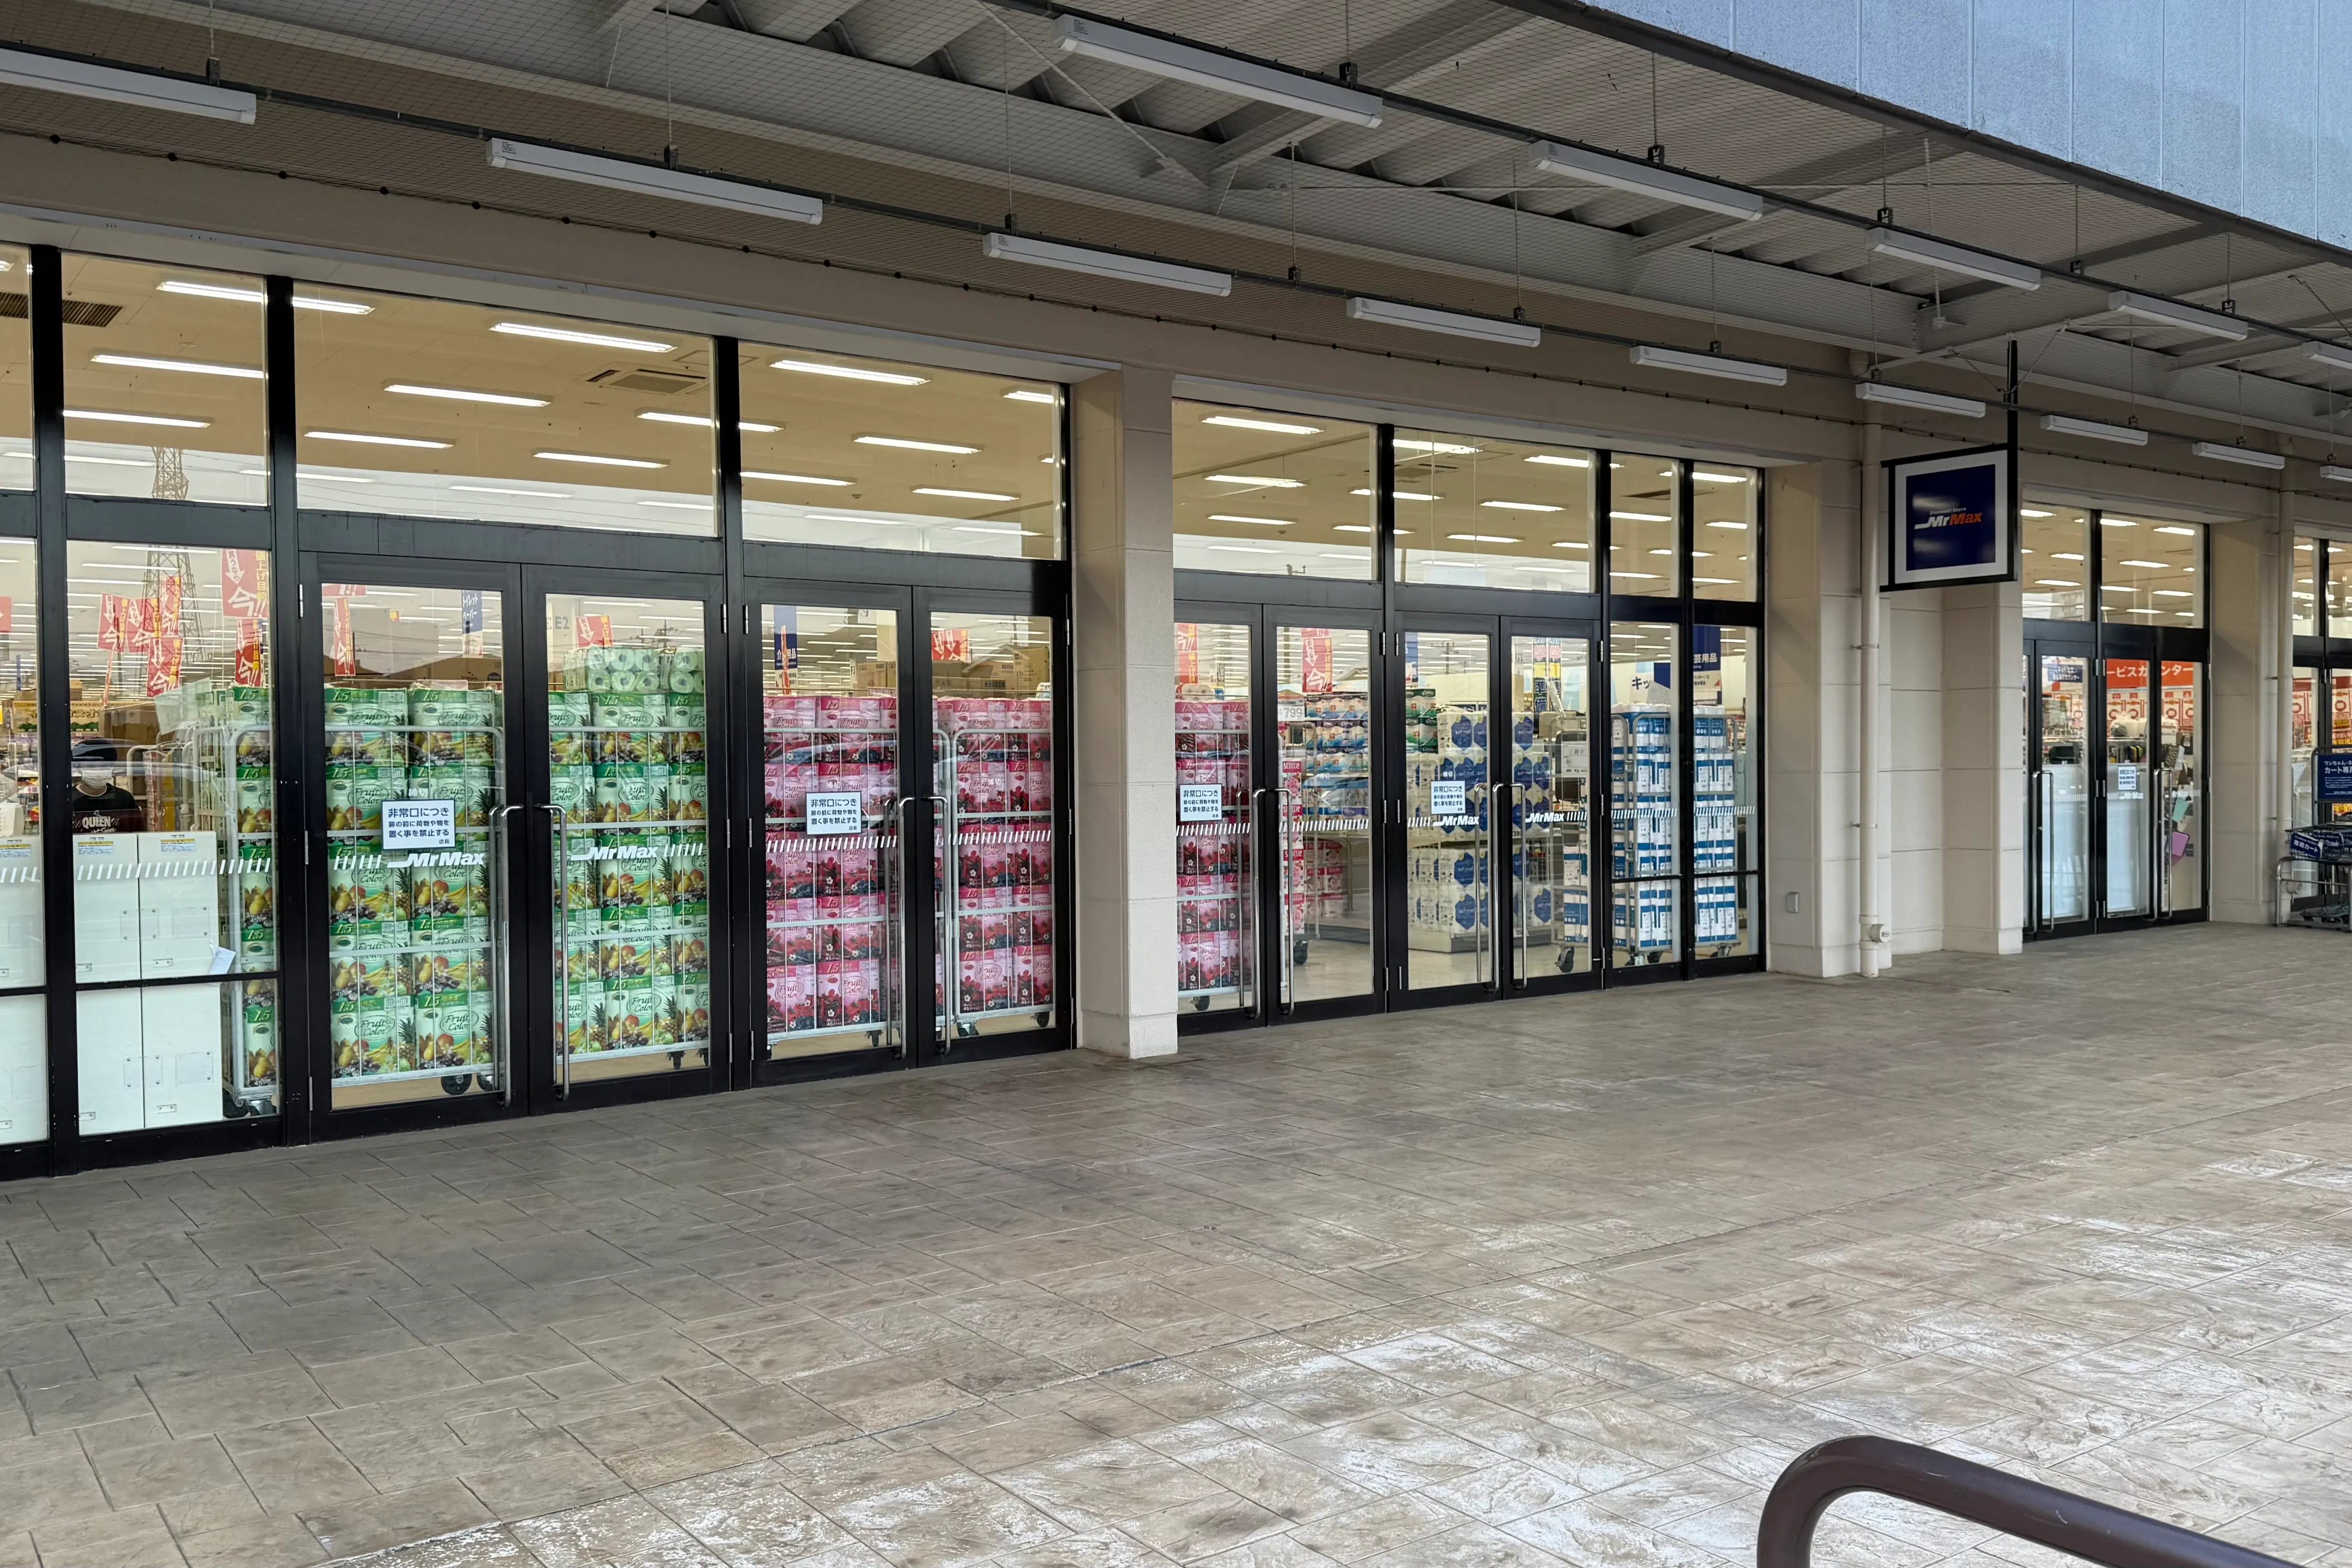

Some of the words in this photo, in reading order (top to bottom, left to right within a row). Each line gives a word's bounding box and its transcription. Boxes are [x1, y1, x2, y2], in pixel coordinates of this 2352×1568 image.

[1914, 512, 1983, 529] MrMax
[555, 616, 569, 630] E2
[777, 648, 796, 660] 介用品
[811, 799, 857, 808] 非常口につき
[388, 808, 449, 818] 非常口につき
[1525, 812, 1564, 823] MrMax
[82, 816, 111, 828] QUEEN
[1433, 815, 1480, 827] MrMax
[389, 829, 449, 838] 置く事を禁止する
[570, 846, 659, 861] MrMax
[387, 852, 486, 868] MrMax
[827, 963, 840, 973] 1.5
[339, 1002, 355, 1012] 1.5
